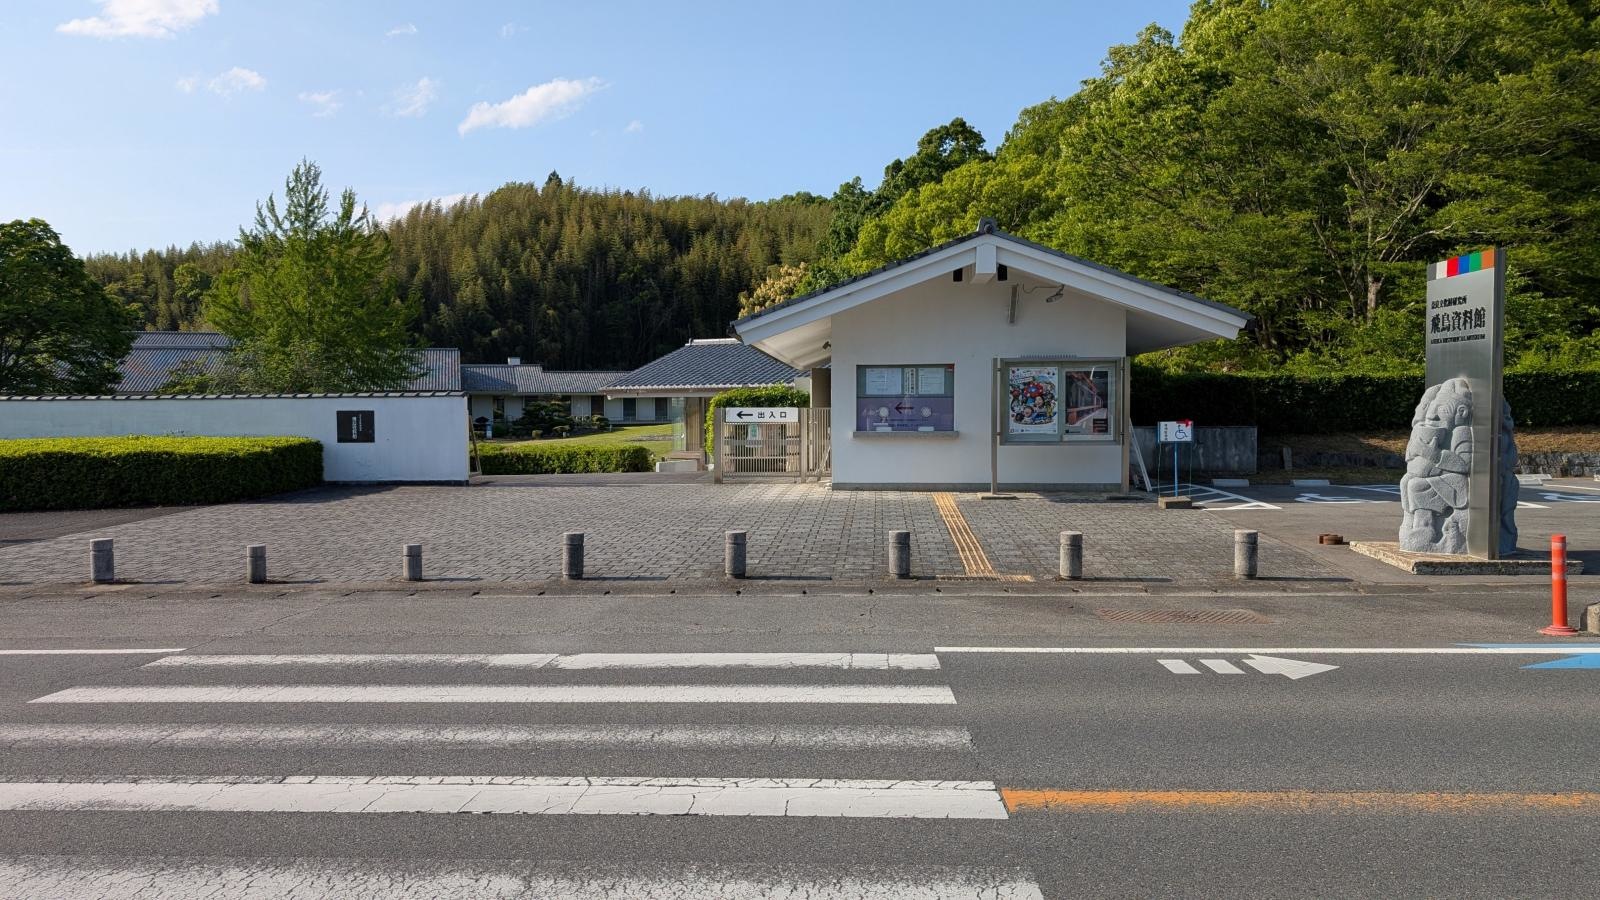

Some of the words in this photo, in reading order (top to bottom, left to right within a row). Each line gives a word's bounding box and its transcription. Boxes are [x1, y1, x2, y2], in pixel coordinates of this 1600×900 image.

[1431, 307, 1486, 333] 飛鳥資料館
[757, 411, 787, 419] 出入口
